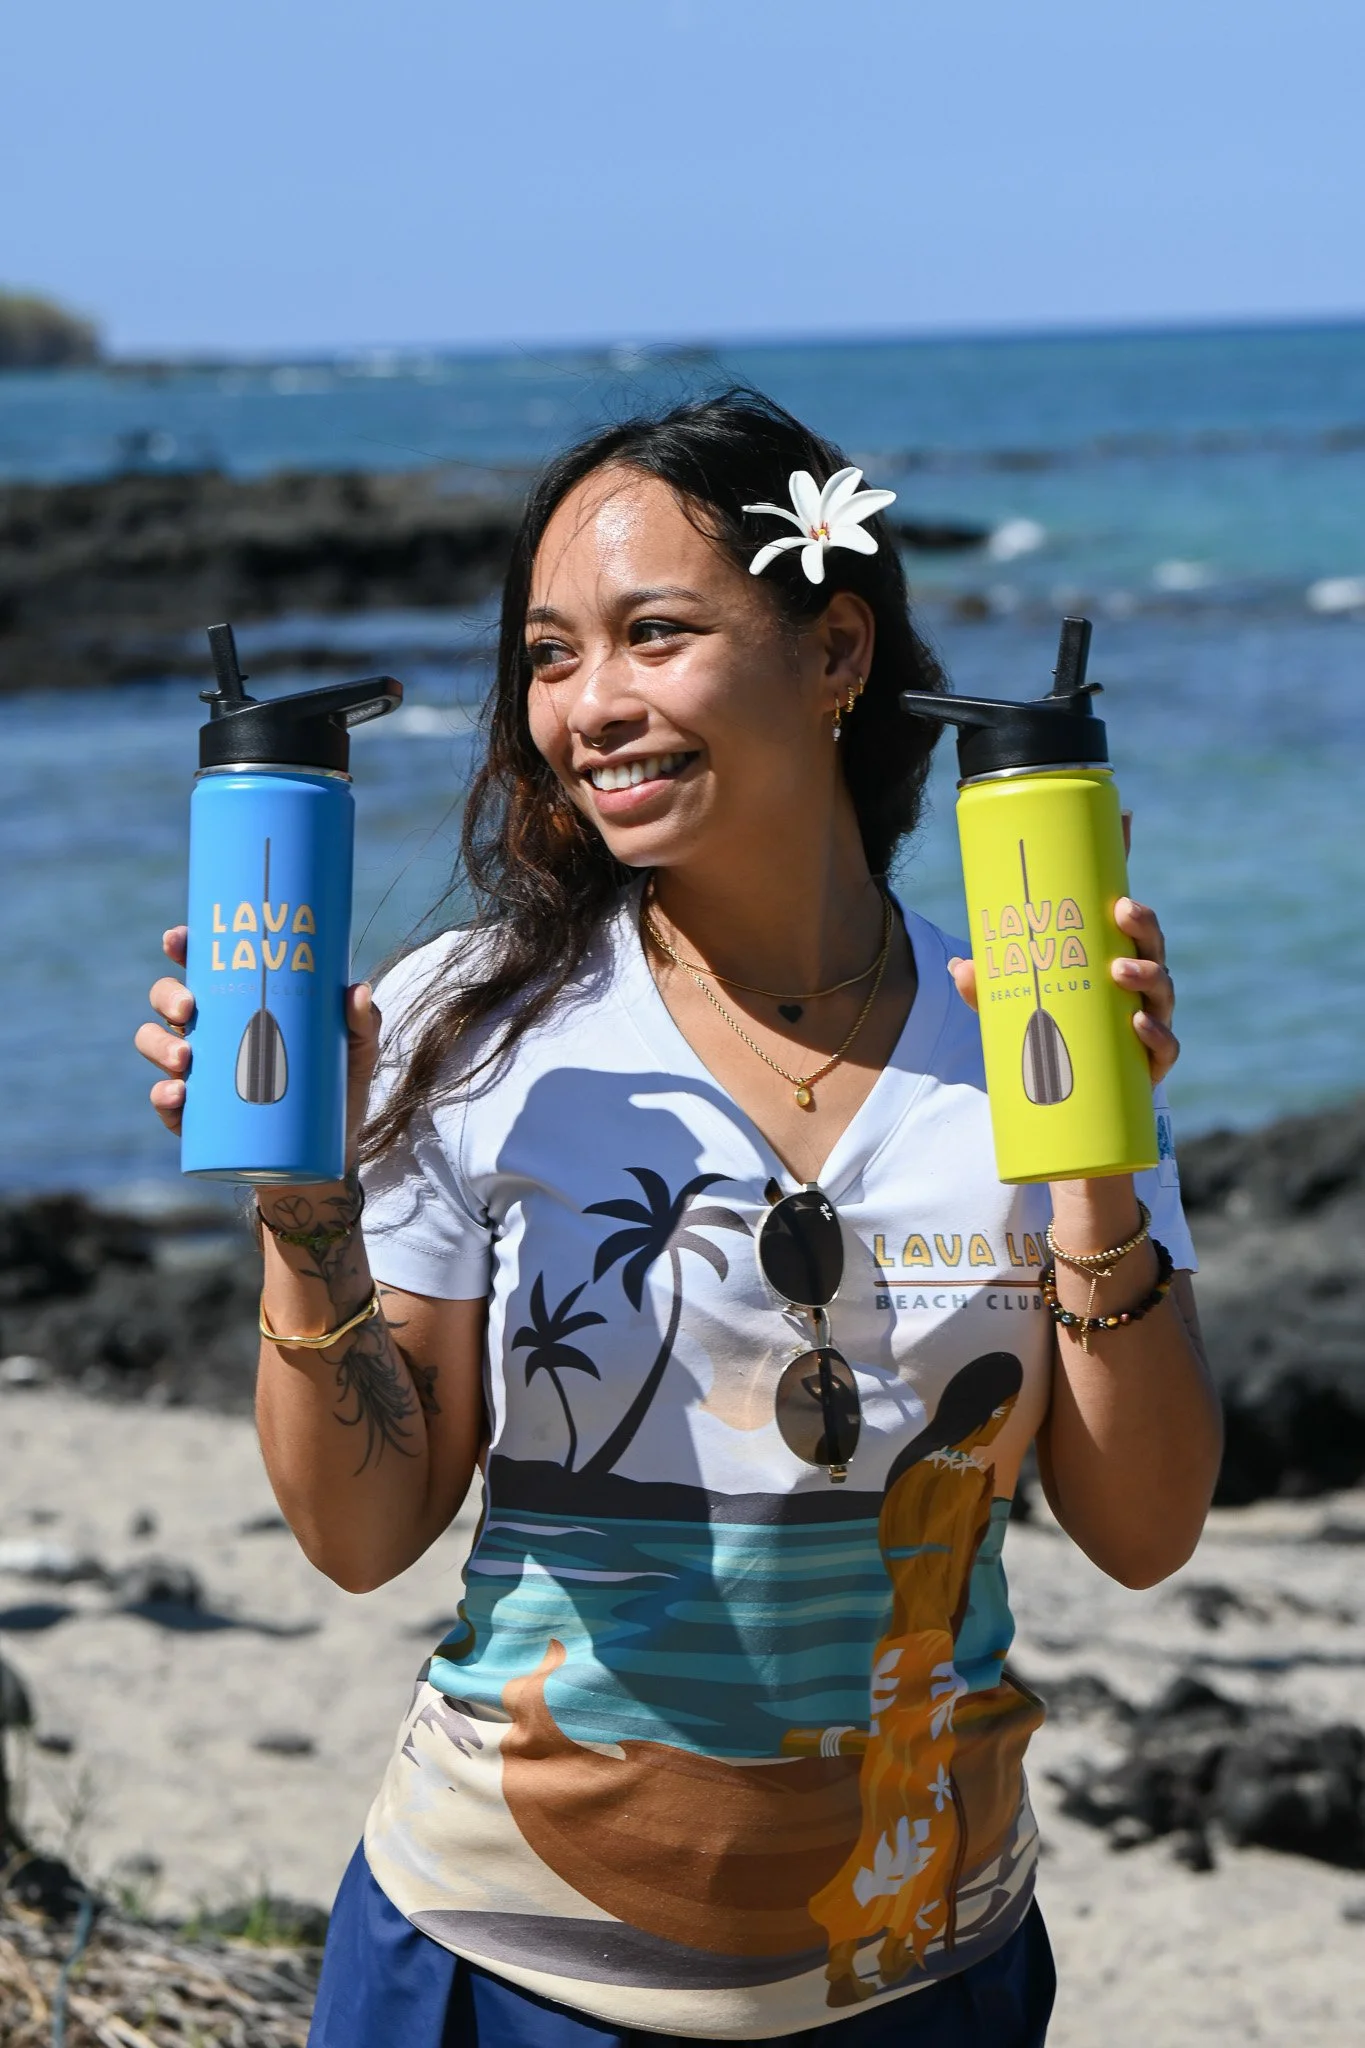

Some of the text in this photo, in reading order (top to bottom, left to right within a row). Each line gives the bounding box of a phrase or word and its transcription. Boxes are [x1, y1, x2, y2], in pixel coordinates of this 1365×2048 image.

[212, 901, 316, 934] LAVA
[982, 898, 1084, 941] LAVA
[211, 939, 315, 972] LAVA
[986, 936, 1088, 979] LAVA
[271, 985, 317, 997] CLU
[990, 979, 1091, 1001] BEACH CLUB
[873, 1231, 1050, 1268] LAVA LAV
[875, 1294, 1041, 1310] BEACH CLUB
